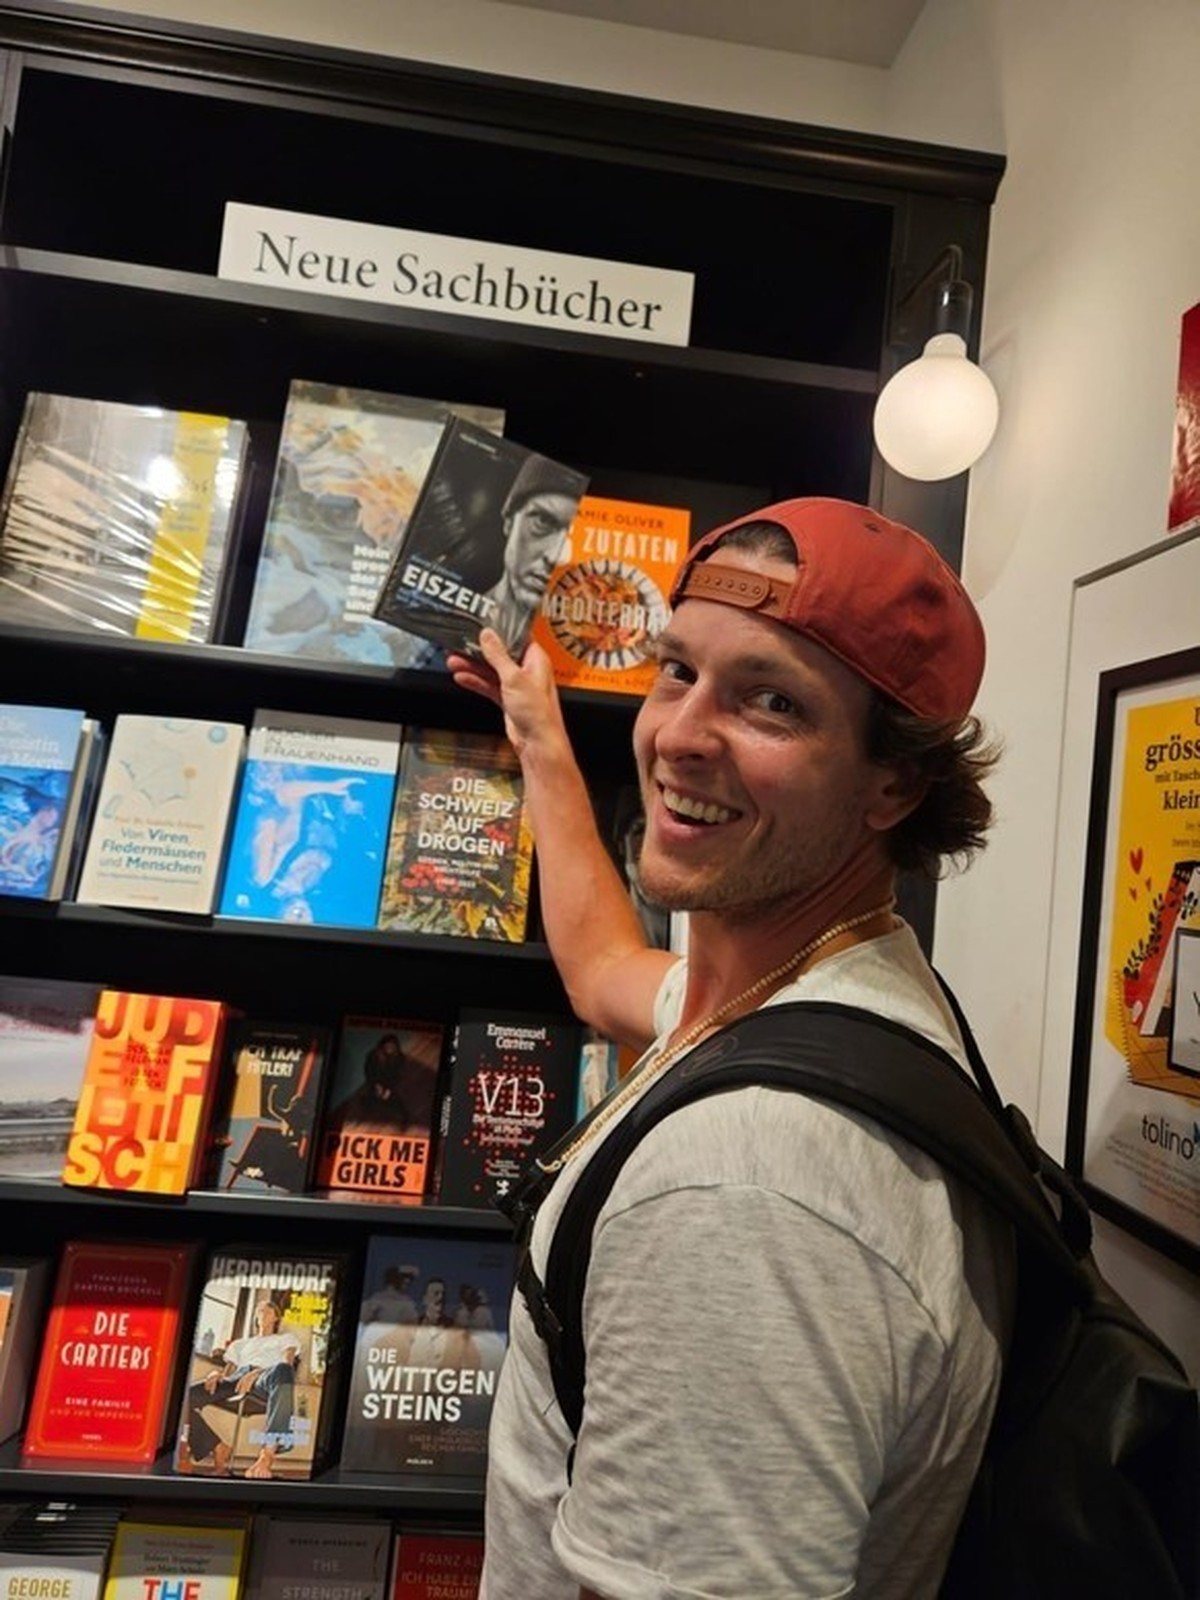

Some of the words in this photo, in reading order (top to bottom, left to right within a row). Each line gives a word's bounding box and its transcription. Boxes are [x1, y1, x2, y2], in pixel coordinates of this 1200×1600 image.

[254, 231, 378, 288] Neue
[393, 252, 663, 331] Sachbücher
[614, 514, 664, 529] OLIVER
[583, 526, 679, 563] ZUTATEN
[402, 563, 496, 618] EISZEIT
[263, 746, 380, 767] FRAUENHAND
[452, 776, 487, 796] DIE
[418, 792, 515, 818] SCHWEIZ
[443, 815, 484, 834] AUF
[417, 832, 506, 856] DROGEN
[126, 856, 202, 875] Menschen
[478, 1072, 546, 1118] V13
[1142, 1114, 1195, 1160] tolino
[389, 1139, 426, 1164] ME
[337, 1160, 407, 1189] GIRLS
[210, 1256, 333, 1293] HERRNDORF
[93, 1310, 130, 1338] DIE
[60, 1341, 152, 1371] CARTIERS
[367, 1348, 397, 1364] DIE
[366, 1365, 496, 1396] WITTGEN
[361, 1393, 462, 1423] STEINS
[313, 1558, 341, 1574] THE
[419, 1552, 461, 1567] FRANZ
[8, 1576, 72, 1599] GEORGE
[144, 1578, 201, 1600] THE
